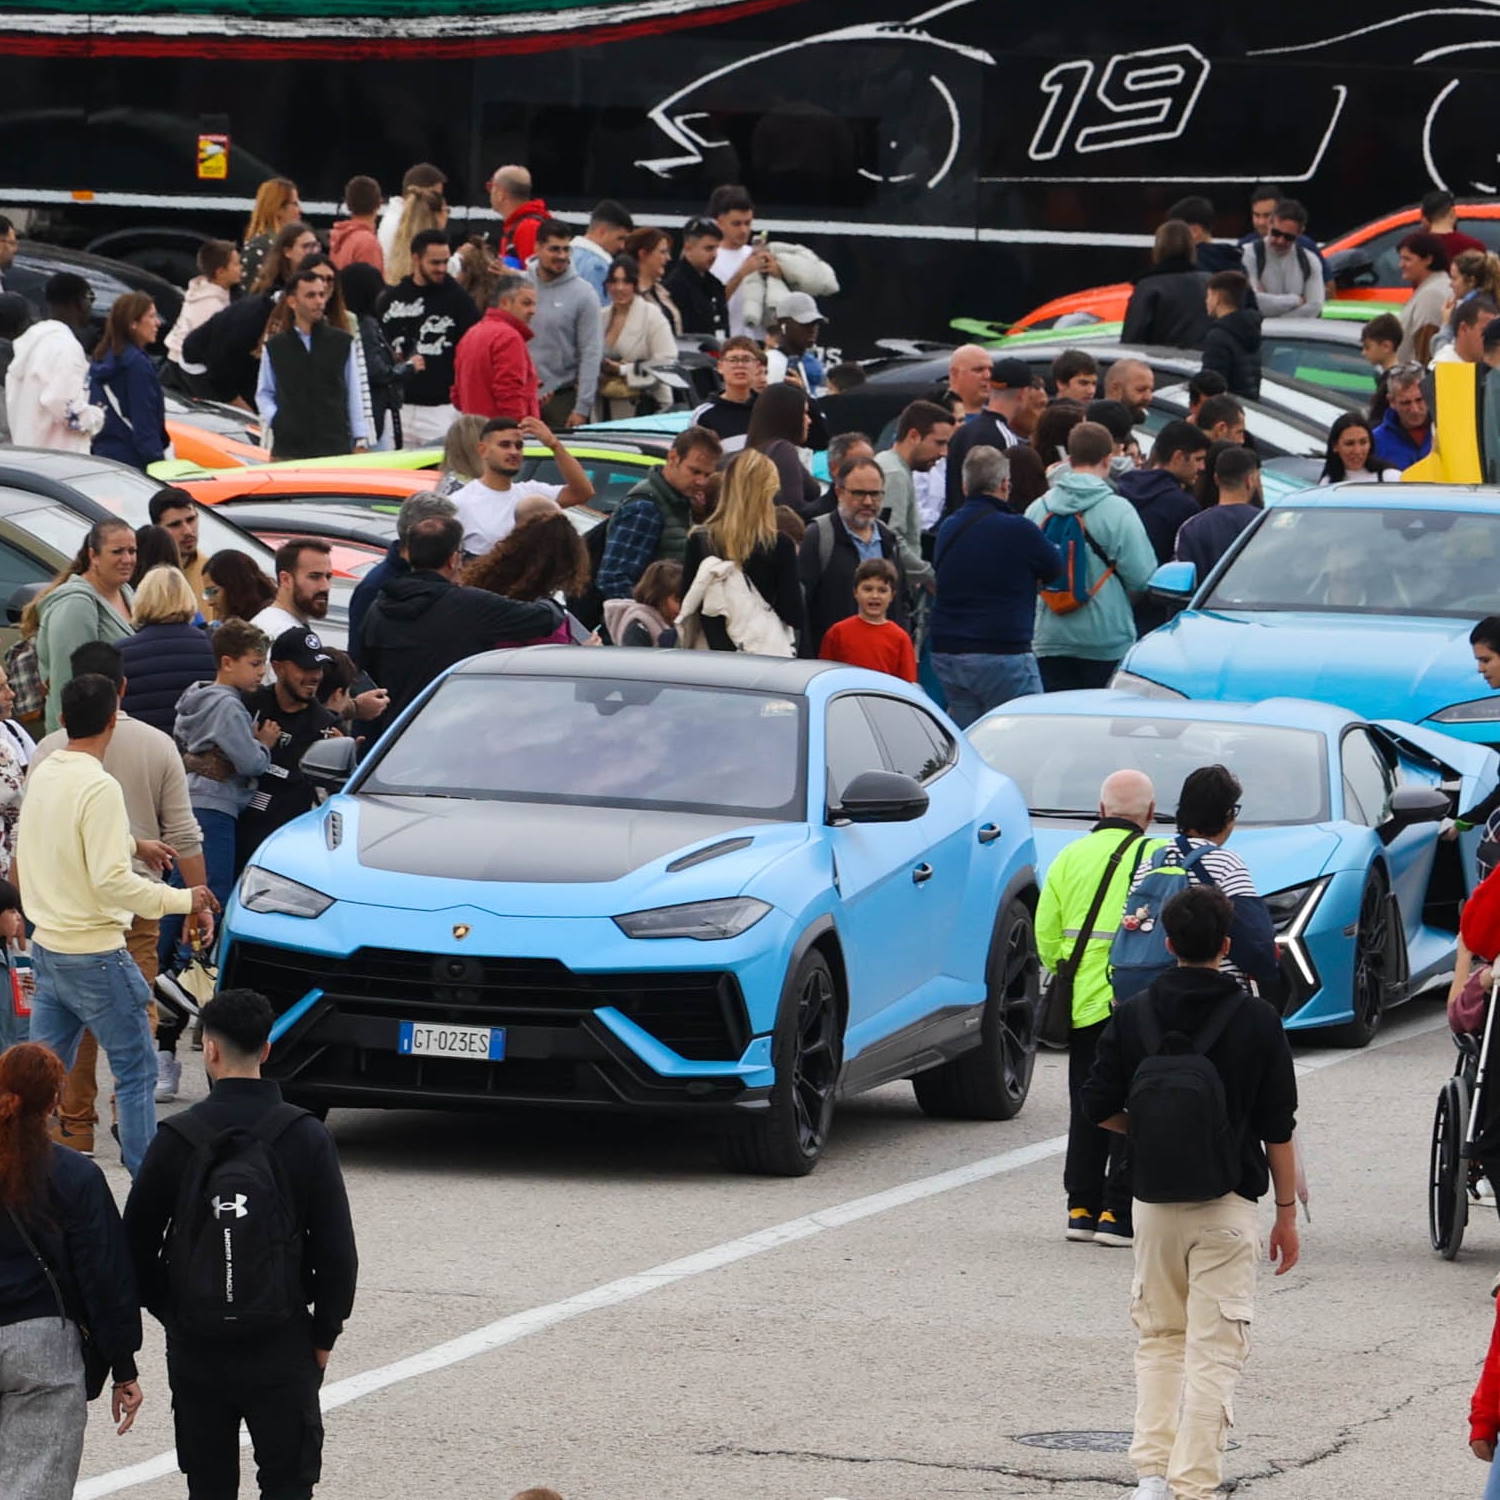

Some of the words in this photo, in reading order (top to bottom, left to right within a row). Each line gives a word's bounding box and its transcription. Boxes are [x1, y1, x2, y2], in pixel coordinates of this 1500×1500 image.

[1027, 44, 1211, 162] 19
[223, 1228, 232, 1261] UNDER
[226, 1261, 234, 1302] ARMOUR
